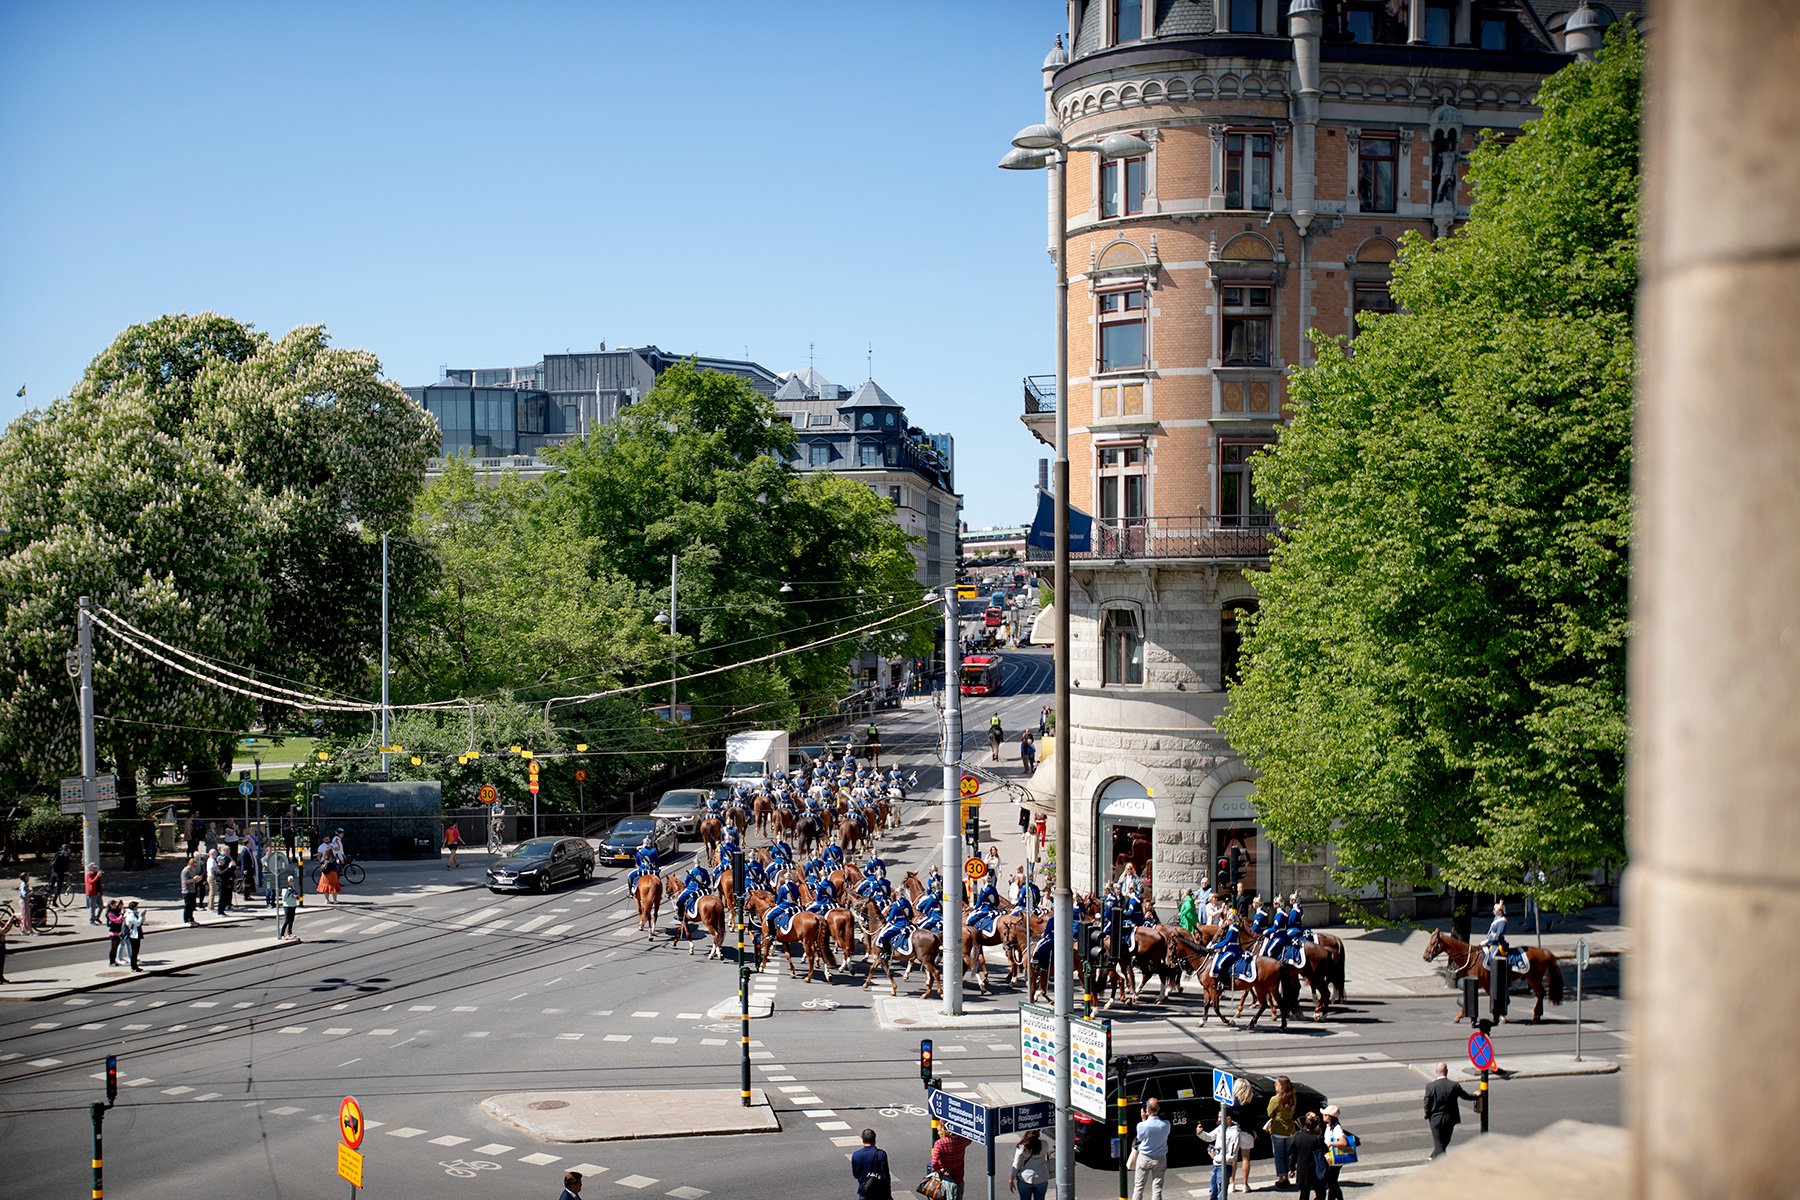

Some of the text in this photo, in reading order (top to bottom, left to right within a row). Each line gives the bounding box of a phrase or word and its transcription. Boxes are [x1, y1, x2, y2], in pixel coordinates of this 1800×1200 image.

[482, 789, 494, 799] 30
[1111, 800, 1145, 810] GUCCI
[1222, 801, 1255, 811] GUCC
[968, 863, 983, 874] 30
[1077, 1027, 1098, 1039] JUDISKA
[1072, 1033, 1104, 1049] HUVUDSAKER
[1172, 1110, 1187, 1119] TOP
[1172, 1117, 1188, 1126] CAB
